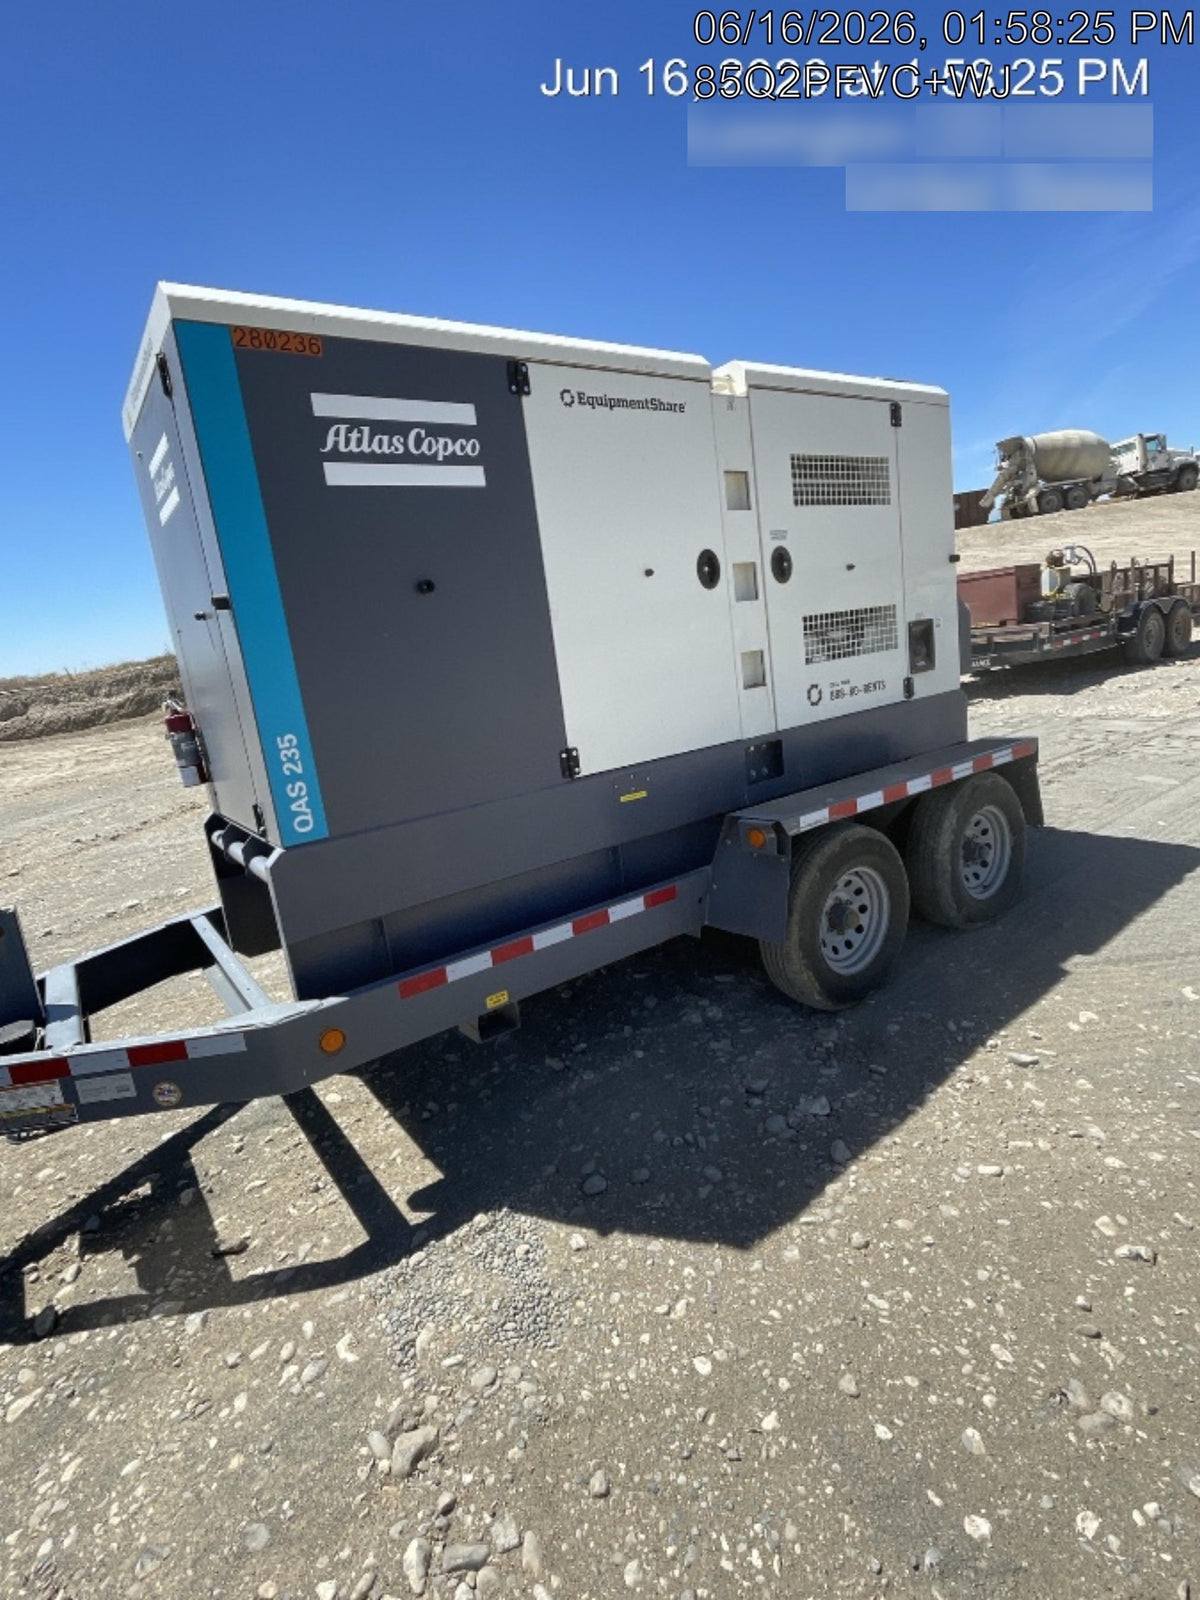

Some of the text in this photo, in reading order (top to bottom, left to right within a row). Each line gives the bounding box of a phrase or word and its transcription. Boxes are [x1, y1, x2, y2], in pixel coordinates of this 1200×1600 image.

[233, 327, 321, 355] 280236
[577, 391, 686, 413] EquipmentShare
[320, 424, 481, 461] Atlas Copco
[277, 733, 314, 833] QAS 235
